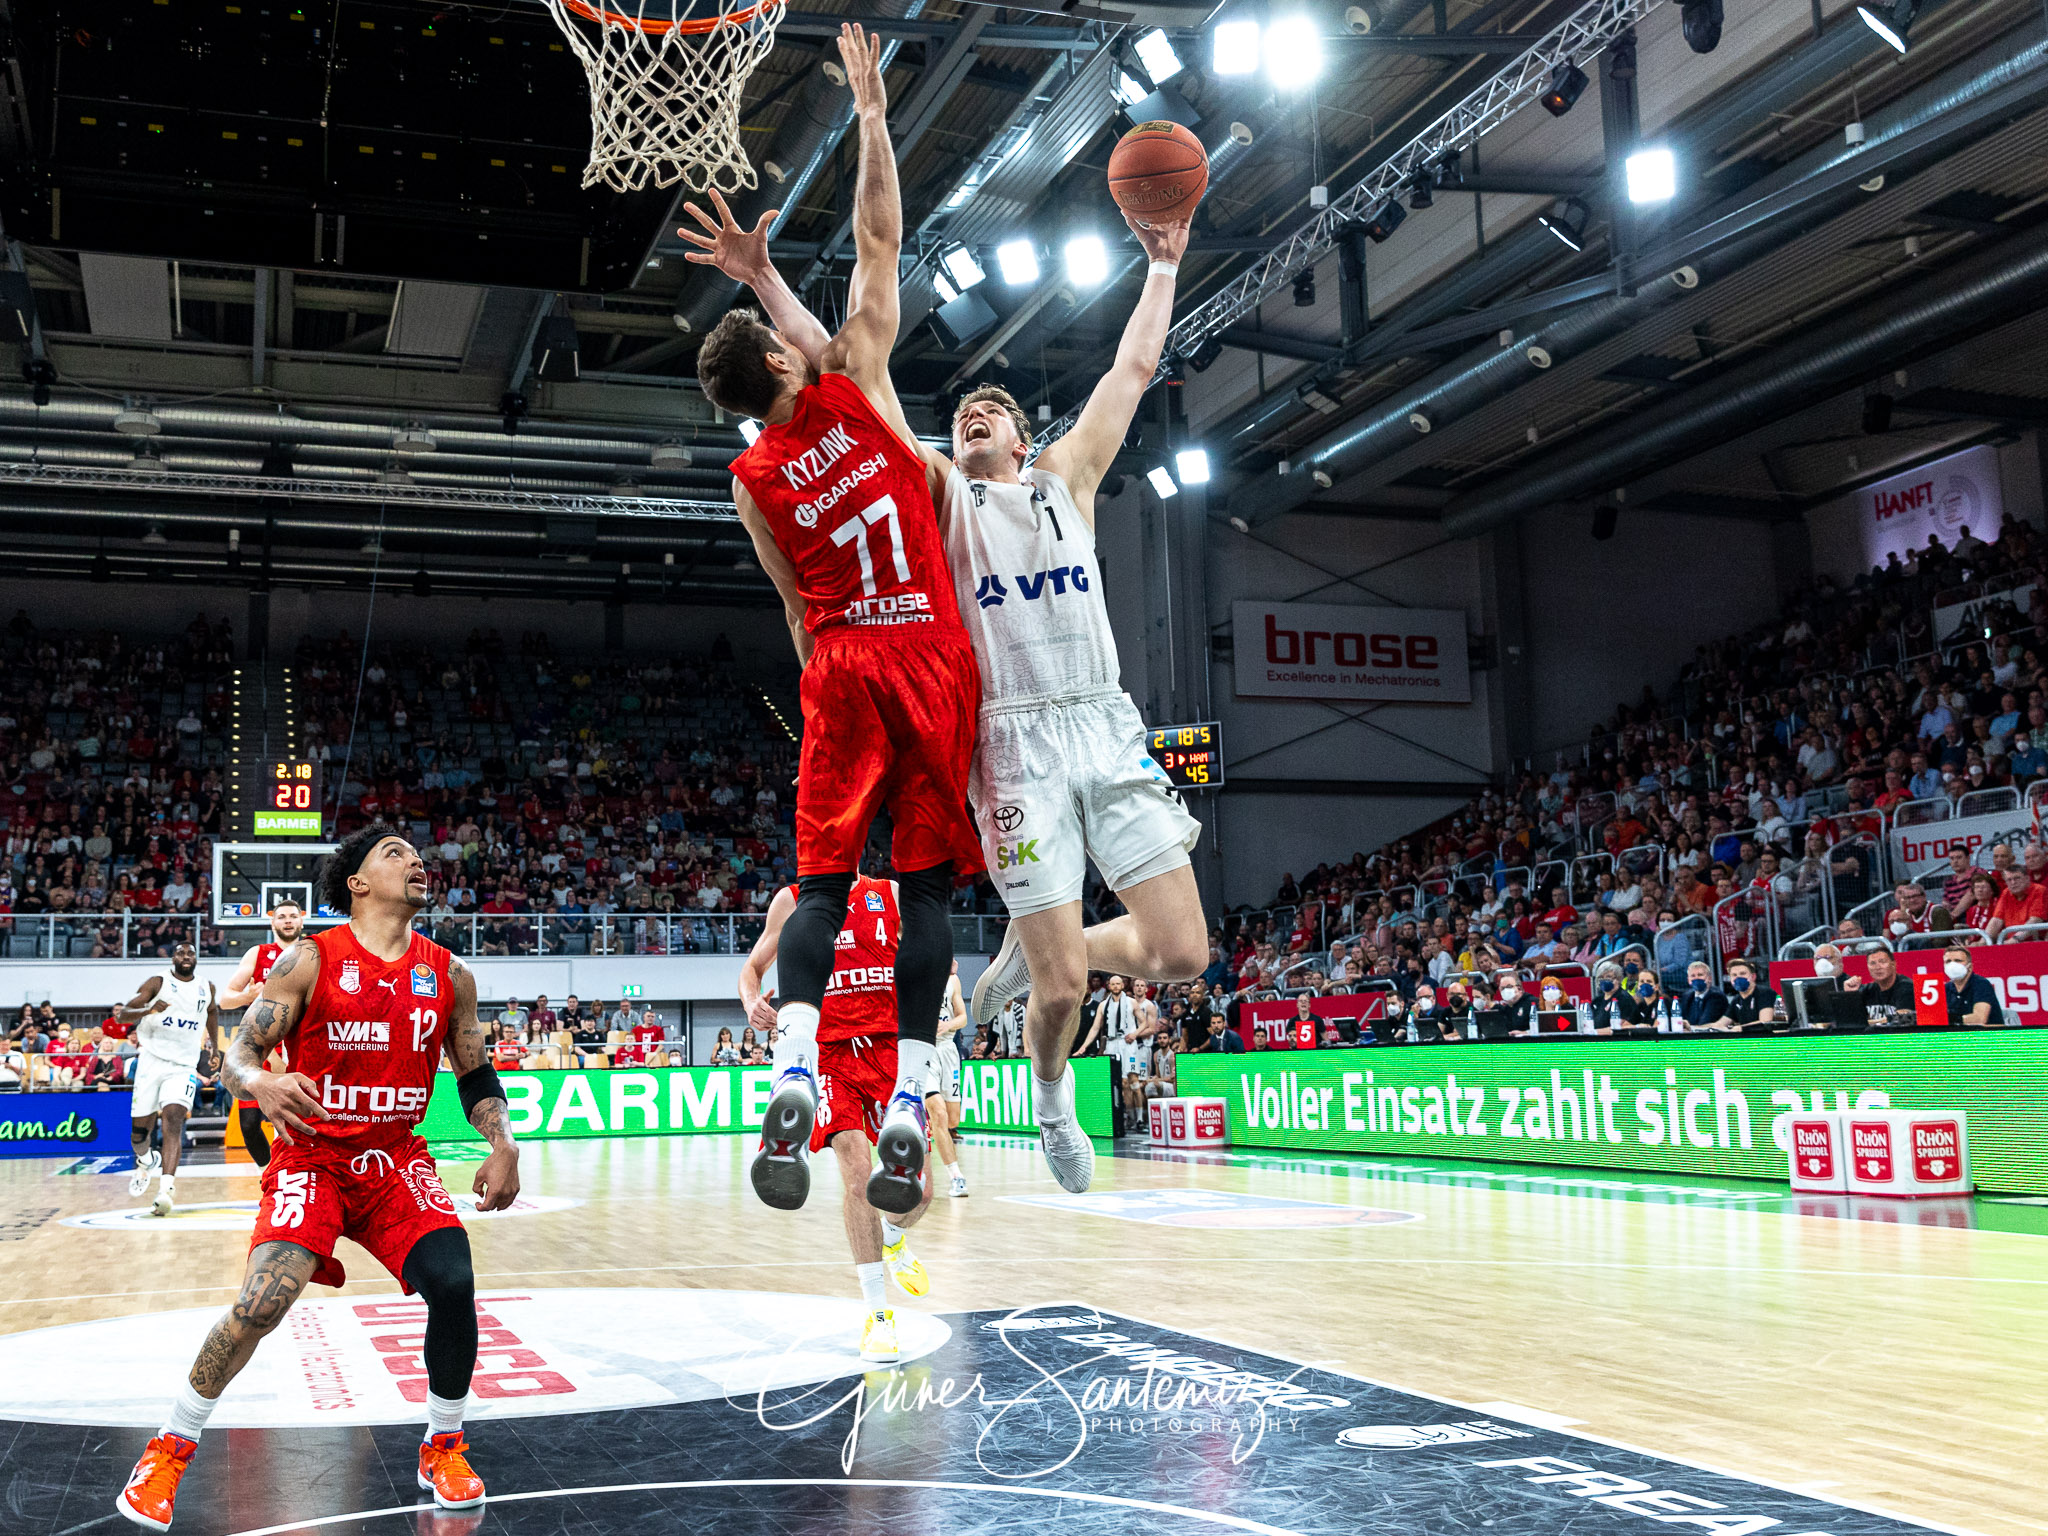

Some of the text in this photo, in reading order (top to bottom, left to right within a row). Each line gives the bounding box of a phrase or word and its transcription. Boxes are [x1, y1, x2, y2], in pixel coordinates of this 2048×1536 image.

[781, 422, 859, 491] KYZLINK
[814, 452, 889, 514] IGARASHI
[1874, 481, 1934, 521] HANFT
[1045, 505, 1063, 541] 1
[829, 494, 912, 597] 77
[1015, 565, 1089, 600] VTG
[1265, 614, 1439, 670] brose
[1267, 671, 1441, 687] Excellence in Mechatronics
[1189, 752, 1209, 764] HAM
[1185, 764, 1209, 783] 45
[275, 784, 311, 808] 20
[257, 817, 319, 830] BARMER
[1005, 879, 1030, 890] SPALDING
[875, 917, 888, 946] 4
[1921, 979, 1939, 1006] 5
[196, 999, 206, 1013] 17
[327, 1021, 371, 1042] LVM
[409, 1007, 438, 1052] 12
[1300, 1025, 1311, 1042] 5
[328, 1042, 389, 1051] VERSICHERUNG
[185, 1084, 195, 1098] 17
[503, 1071, 773, 1133] BARME
[1241, 1070, 1333, 1130] Voller
[1342, 1069, 1488, 1136] Einsatz
[1498, 1068, 1622, 1144] zahlt
[1635, 1068, 1753, 1149] sich
[371, 1114, 380, 1123] in
[1197, 1108, 1221, 1119] RHÖN
[1797, 1128, 1827, 1146] RHÖN
[1855, 1128, 1887, 1147] RHÖN
[1916, 1128, 1954, 1147] RHÖN
[1798, 1146, 1829, 1157] SPRUDEL
[1856, 1146, 1889, 1158] SPRUDEL
[1917, 1146, 1955, 1158] SPRUDEL
